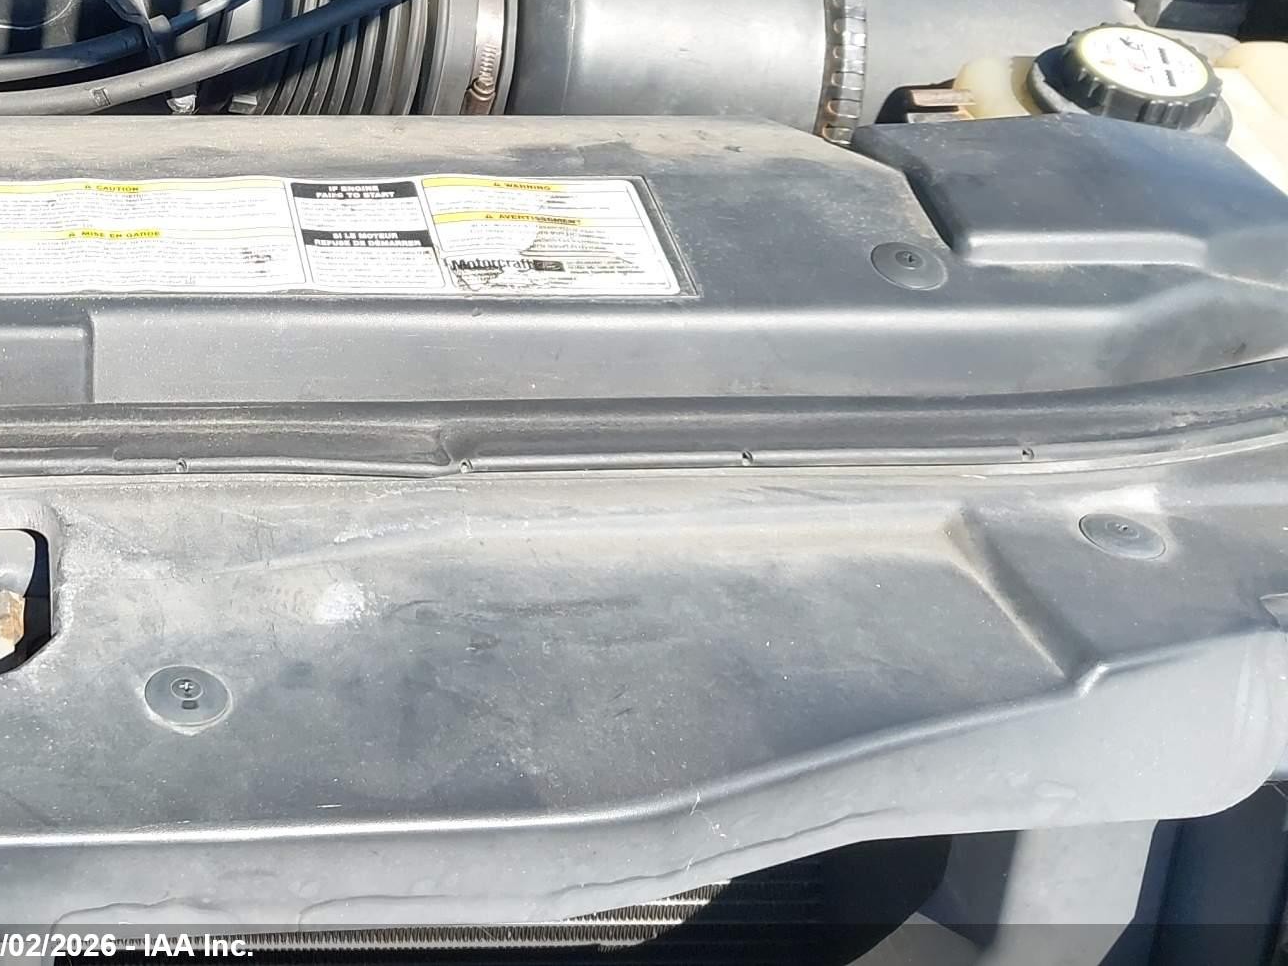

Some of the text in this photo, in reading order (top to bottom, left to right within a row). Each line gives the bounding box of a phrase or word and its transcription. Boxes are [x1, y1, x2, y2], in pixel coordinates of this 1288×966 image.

[96, 184, 140, 192] CAUTION
[328, 184, 380, 193] IF ENGINE
[504, 182, 552, 191] WARNING
[363, 191, 396, 199] START
[344, 232, 357, 240] LE
[358, 232, 399, 240] MOTEUR
[352, 239, 367, 247] DE
[451, 258, 534, 272] Motorcraft
